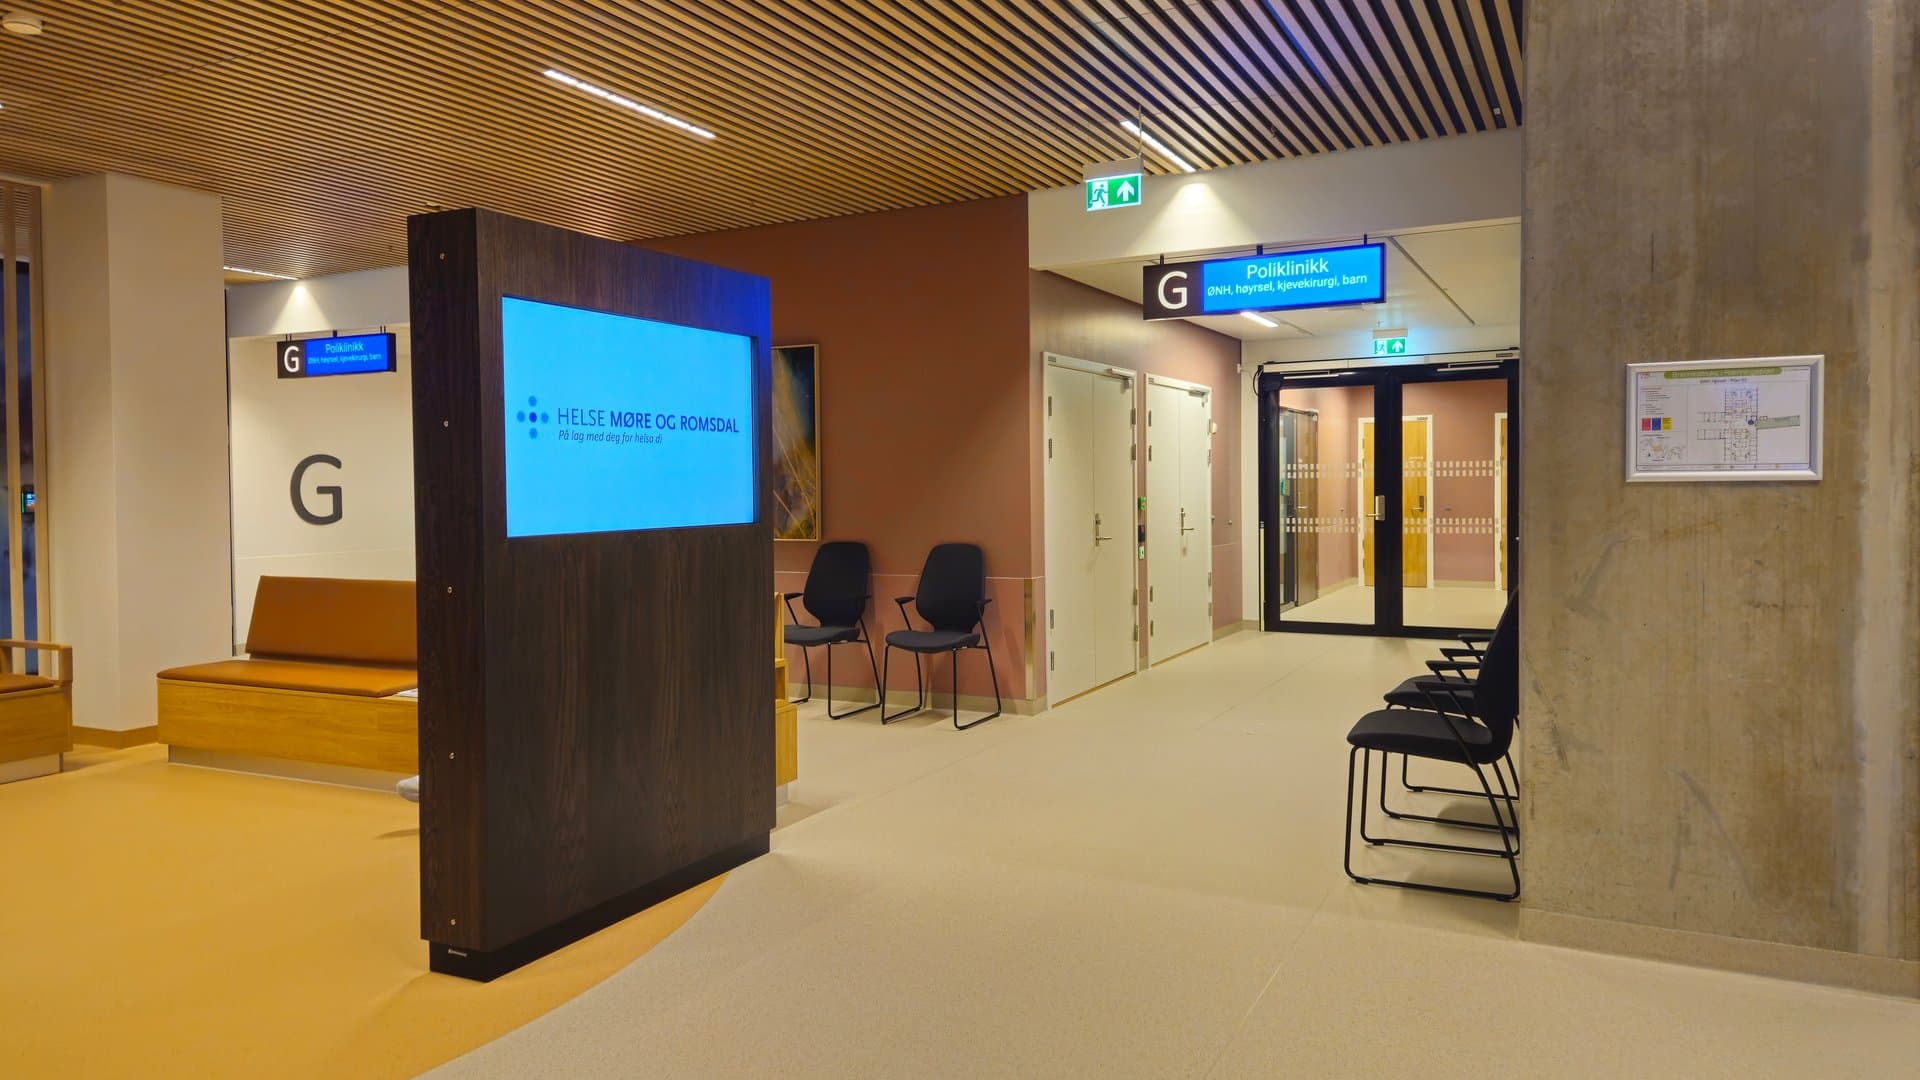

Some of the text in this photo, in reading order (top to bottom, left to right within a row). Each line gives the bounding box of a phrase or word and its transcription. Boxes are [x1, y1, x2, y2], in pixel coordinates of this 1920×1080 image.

[1247, 258, 1329, 280] Poliklinikk
[1157, 270, 1188, 310] G
[1207, 274, 1367, 297] ØNH, høyrsel, kjevekirurgi, barn
[283, 346, 300, 373] G
[325, 341, 364, 354] Poliklinikk
[558, 407, 740, 433] HELSE MØRE OG ROMSDAL
[558, 429, 663, 445] På lag med deg for helsa di
[290, 453, 343, 525] G
